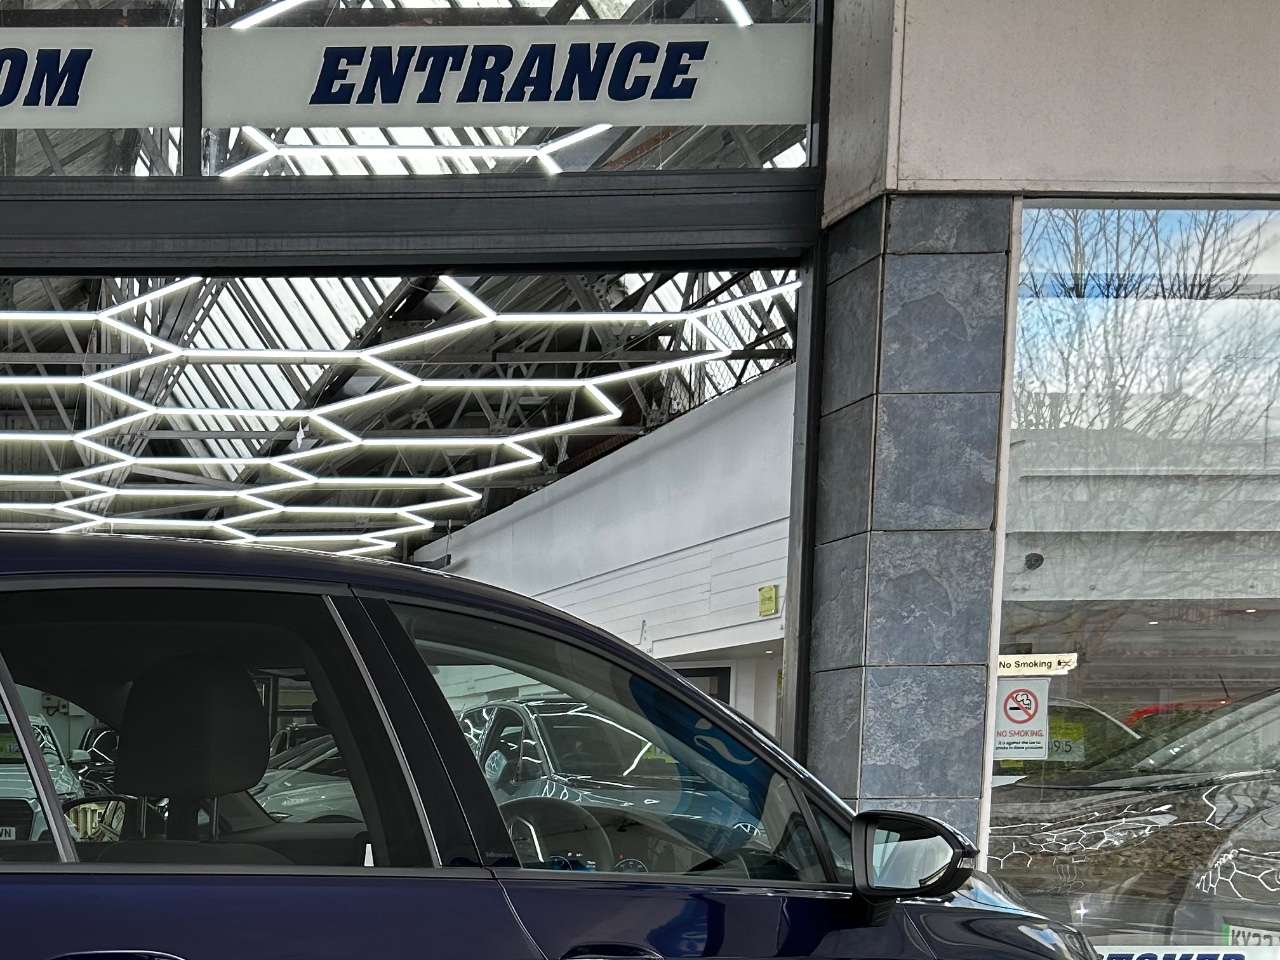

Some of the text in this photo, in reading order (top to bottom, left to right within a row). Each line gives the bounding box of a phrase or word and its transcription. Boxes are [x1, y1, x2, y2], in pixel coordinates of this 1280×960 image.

[308, 40, 710, 105] ENTRANCE
[999, 660, 1052, 669] No Smoking
